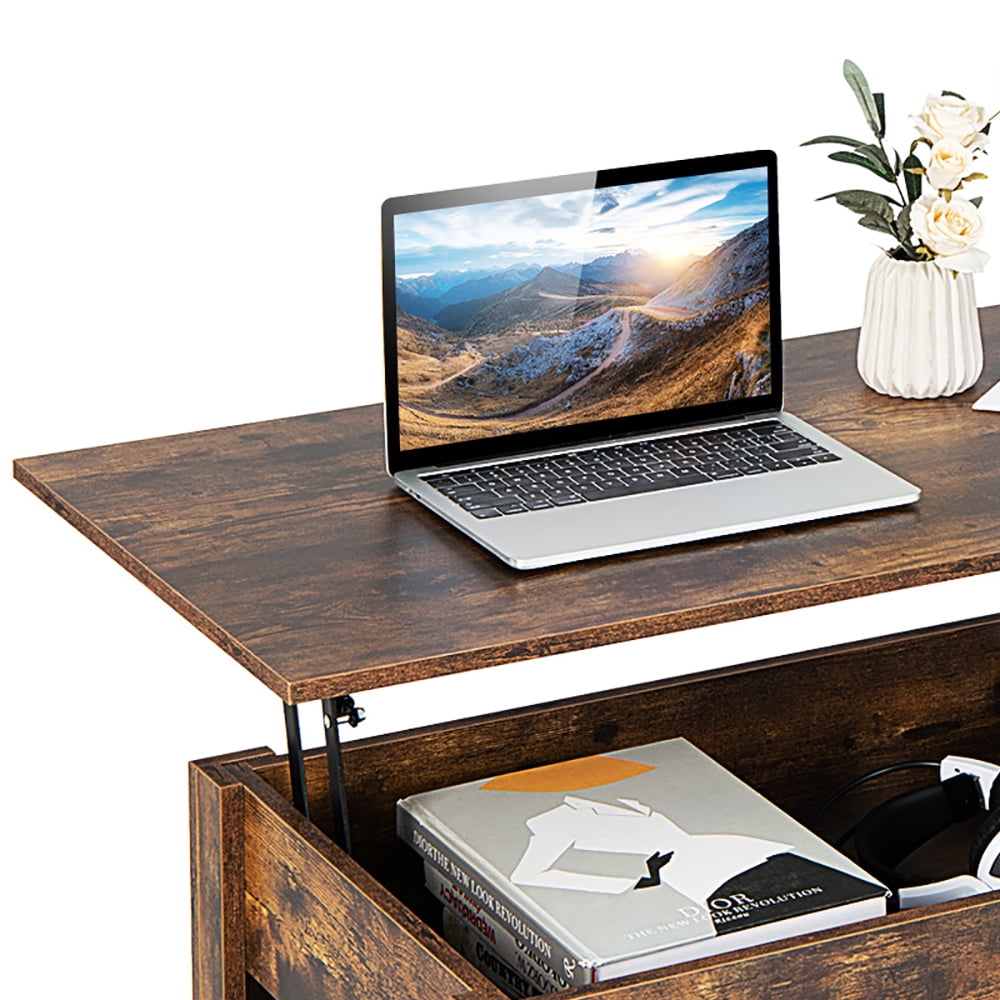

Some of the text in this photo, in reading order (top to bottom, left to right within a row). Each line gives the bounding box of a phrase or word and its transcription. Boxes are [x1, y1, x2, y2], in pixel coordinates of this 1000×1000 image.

[677, 892, 754, 919] DOR
[733, 886, 823, 913] REVOLUTION
[471, 880, 495, 912] LOOK
[495, 902, 552, 959] REVOLUTION
